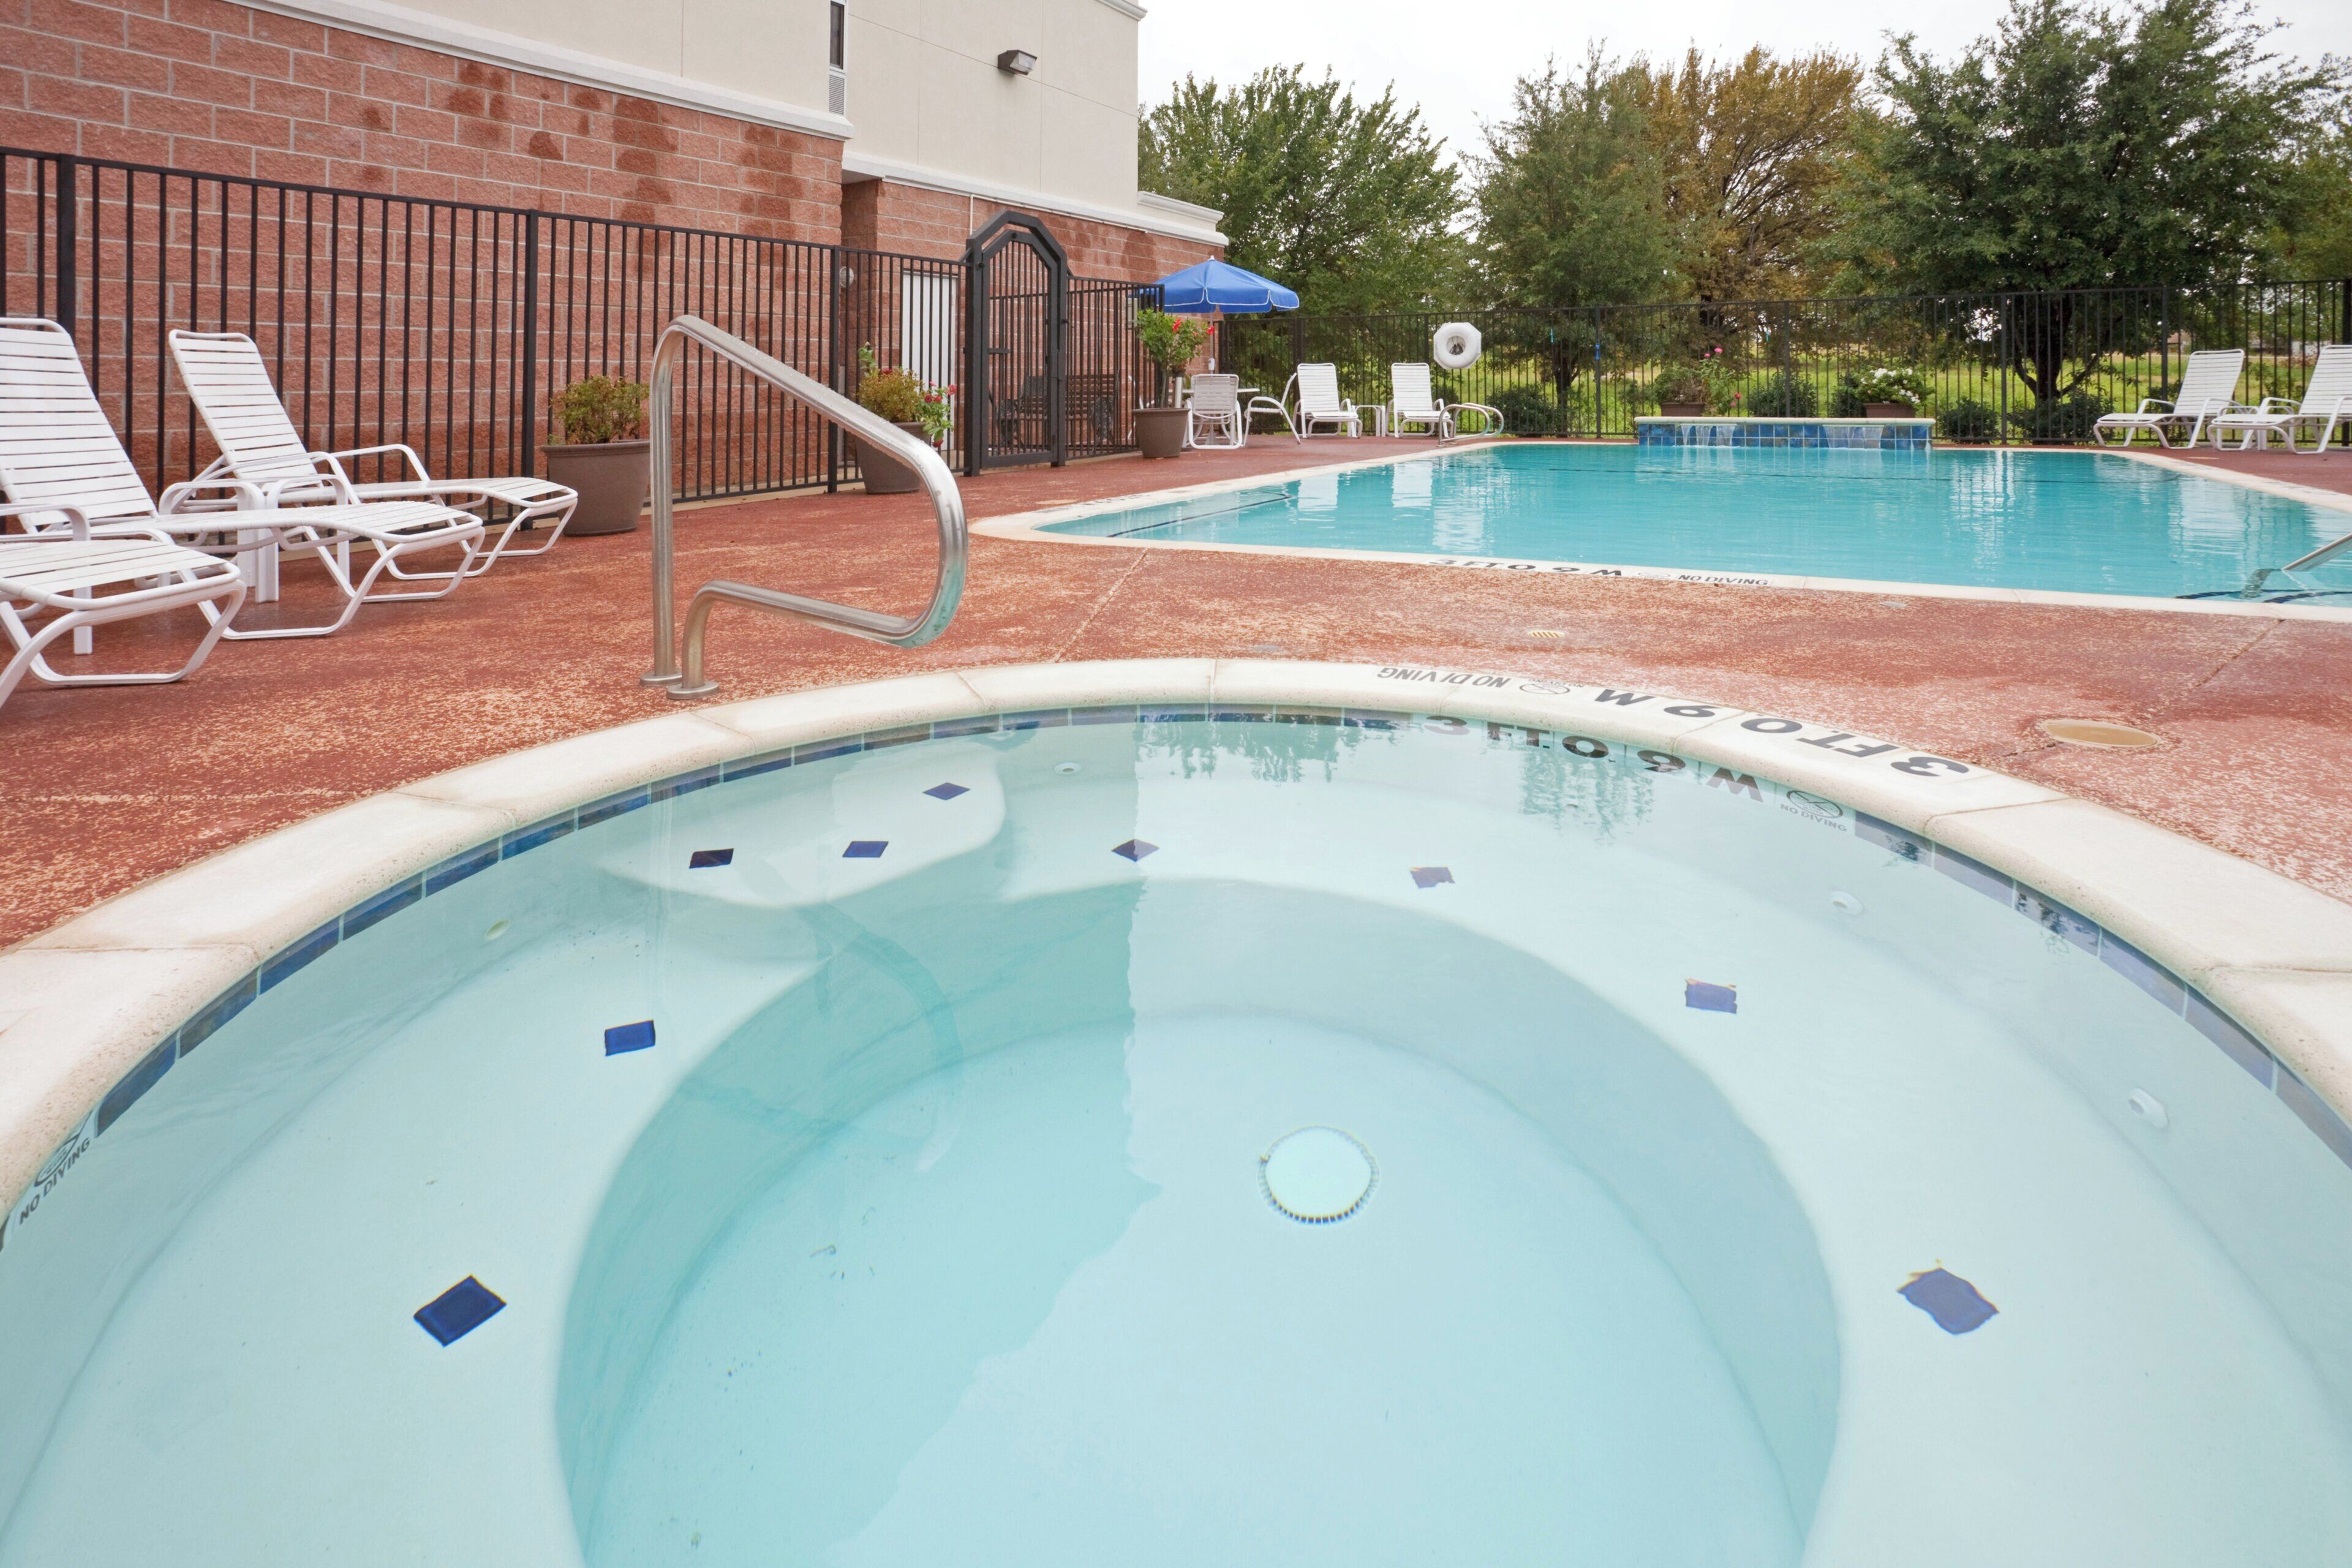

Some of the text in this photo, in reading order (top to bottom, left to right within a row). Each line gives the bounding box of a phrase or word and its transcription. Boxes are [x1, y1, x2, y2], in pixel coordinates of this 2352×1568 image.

[1705, 576, 1769, 586] DIVING
[1378, 667, 1512, 688] NO DIVING
[1594, 688, 1656, 706] M
[1422, 715, 1471, 736] 3
[1706, 767, 1763, 803] M
[1890, 756, 1969, 777] 3
[1780, 803, 1798, 815] NO
[1800, 810, 1847, 832] DIVING
[19, 1137, 90, 1225] NO DIVING
